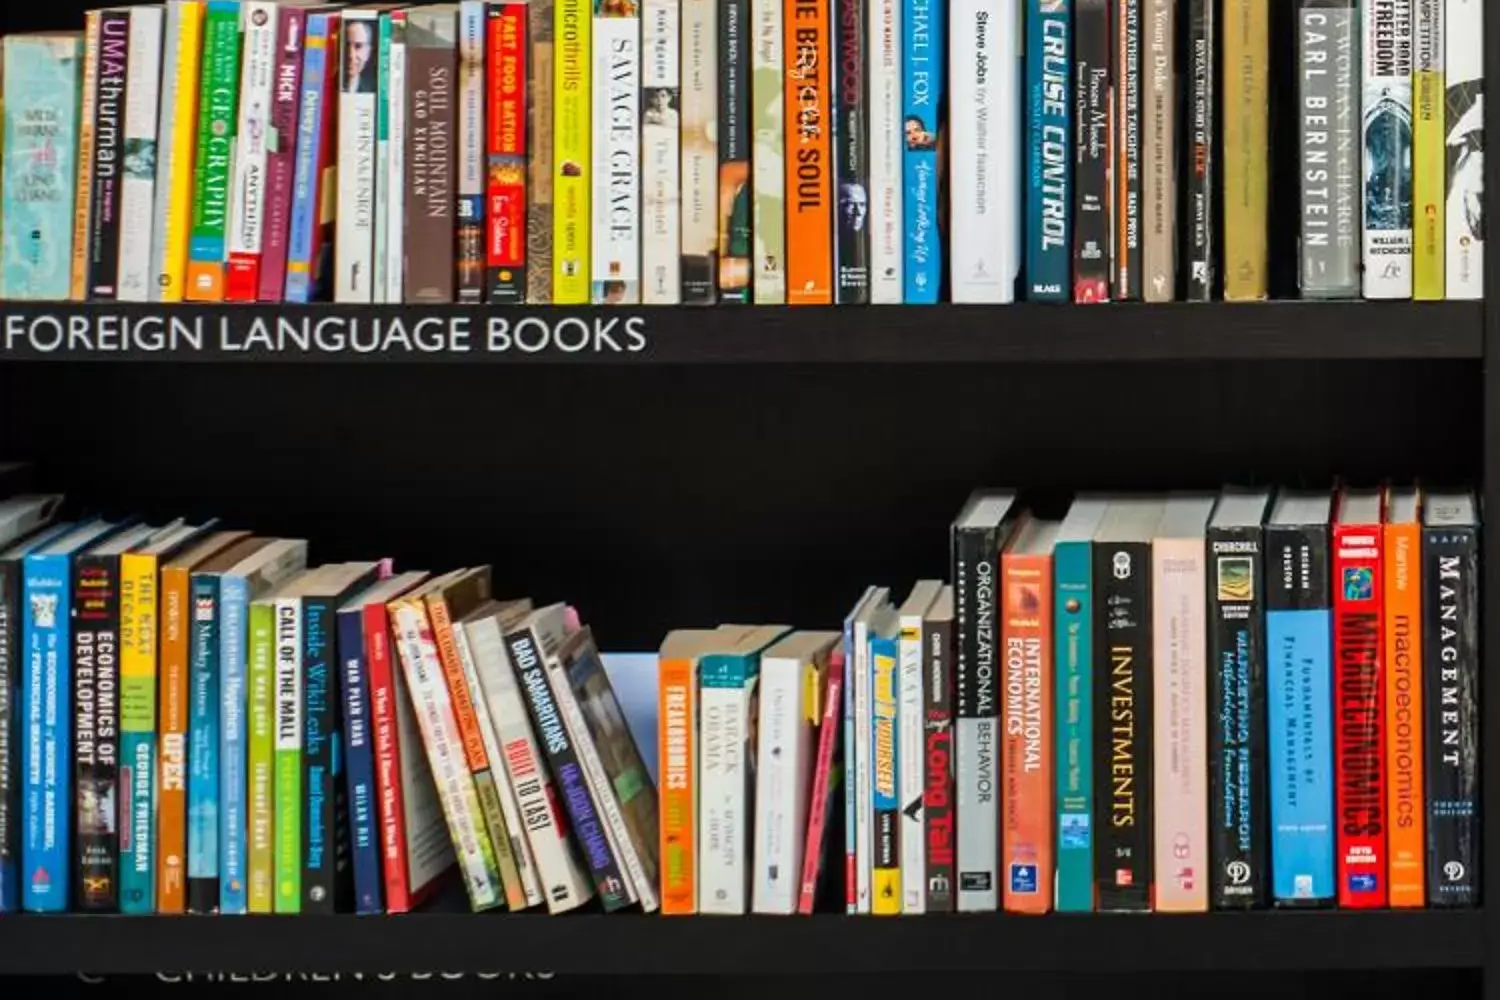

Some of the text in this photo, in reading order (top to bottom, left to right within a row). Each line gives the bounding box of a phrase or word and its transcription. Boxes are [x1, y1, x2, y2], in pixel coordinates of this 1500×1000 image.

[502, 15, 518, 152] FAST FOOD NATION
[912, 71, 929, 106] FOX
[1127, 29, 1138, 162] FATHER NEVER TAUGHT
[1152, 11, 1167, 52] Young
[1153, 55, 1167, 91] Duke
[1375, 1, 1395, 77] FREEDOM
[1396, 40, 1410, 77] ROAD
[414, 90, 426, 119] GAO
[428, 67, 448, 218] SOUL MOUNTAIN
[610, 37, 633, 242] SAVAGE GRACE
[975, 11, 989, 215] Steve Jobs Walter Isaacson
[1040, 19, 1066, 251] CRUISE CONTROL
[1304, 13, 1329, 247] CARL BERNSTEIN
[797, 149, 821, 213] SOUL
[4, 315, 647, 353] FOREIGN LANGUAGE BOOKS
[76, 632, 94, 765] DEVELOPMENT
[97, 631, 116, 765] ECONOMICS OF
[223, 677, 241, 742] Happiness
[279, 606, 295, 740] CALL OF THE MALL
[305, 604, 325, 755] Inside WikiLeaks
[510, 638, 567, 756] BAD SAMARITANS
[976, 561, 992, 804] ORGANIZATIONAL BEHAVIOR
[1007, 637, 1023, 735] ECONOMICS
[1023, 637, 1041, 773] INTERNATIONAL
[1339, 612, 1381, 838] MICROECONOMICS
[1393, 614, 1417, 829] macroeconomics
[1438, 555, 1461, 767] MANAGEMENT
[162, 733, 185, 790] OPEC
[666, 685, 687, 790] FREAKONOMICS
[705, 705, 721, 772] OBAMA
[724, 703, 739, 775] BARACK
[925, 731, 951, 865] Long Tail
[1111, 645, 1134, 828] INVESTMENTS
[135, 743, 149, 872] GEORGE FRIEDMAN
